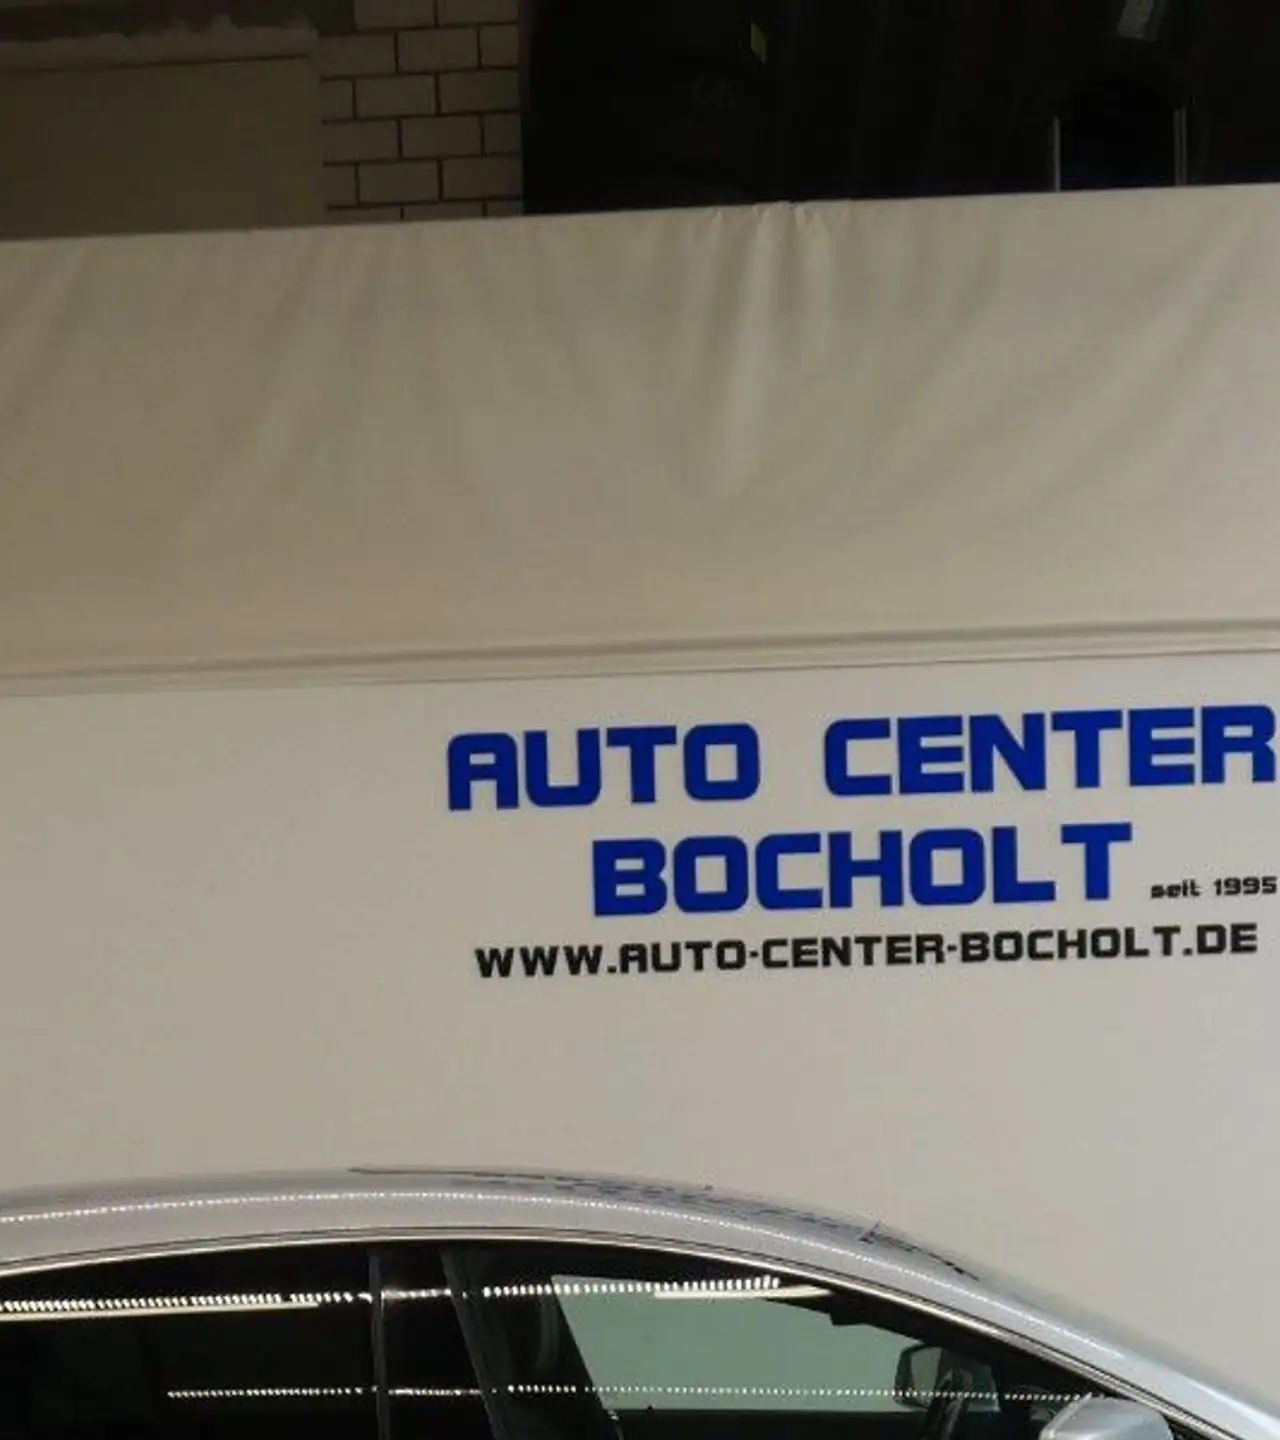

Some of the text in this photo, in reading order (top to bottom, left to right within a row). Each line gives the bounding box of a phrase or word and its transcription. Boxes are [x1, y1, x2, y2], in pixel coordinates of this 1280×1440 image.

[446, 705, 1276, 812] AUTO CENTER
[591, 822, 1133, 918] BOCHOLT
[1150, 875, 1278, 899] seit 1995
[474, 922, 1259, 979] WWW.AUTO-CENTER-BOCHOLT.DE
